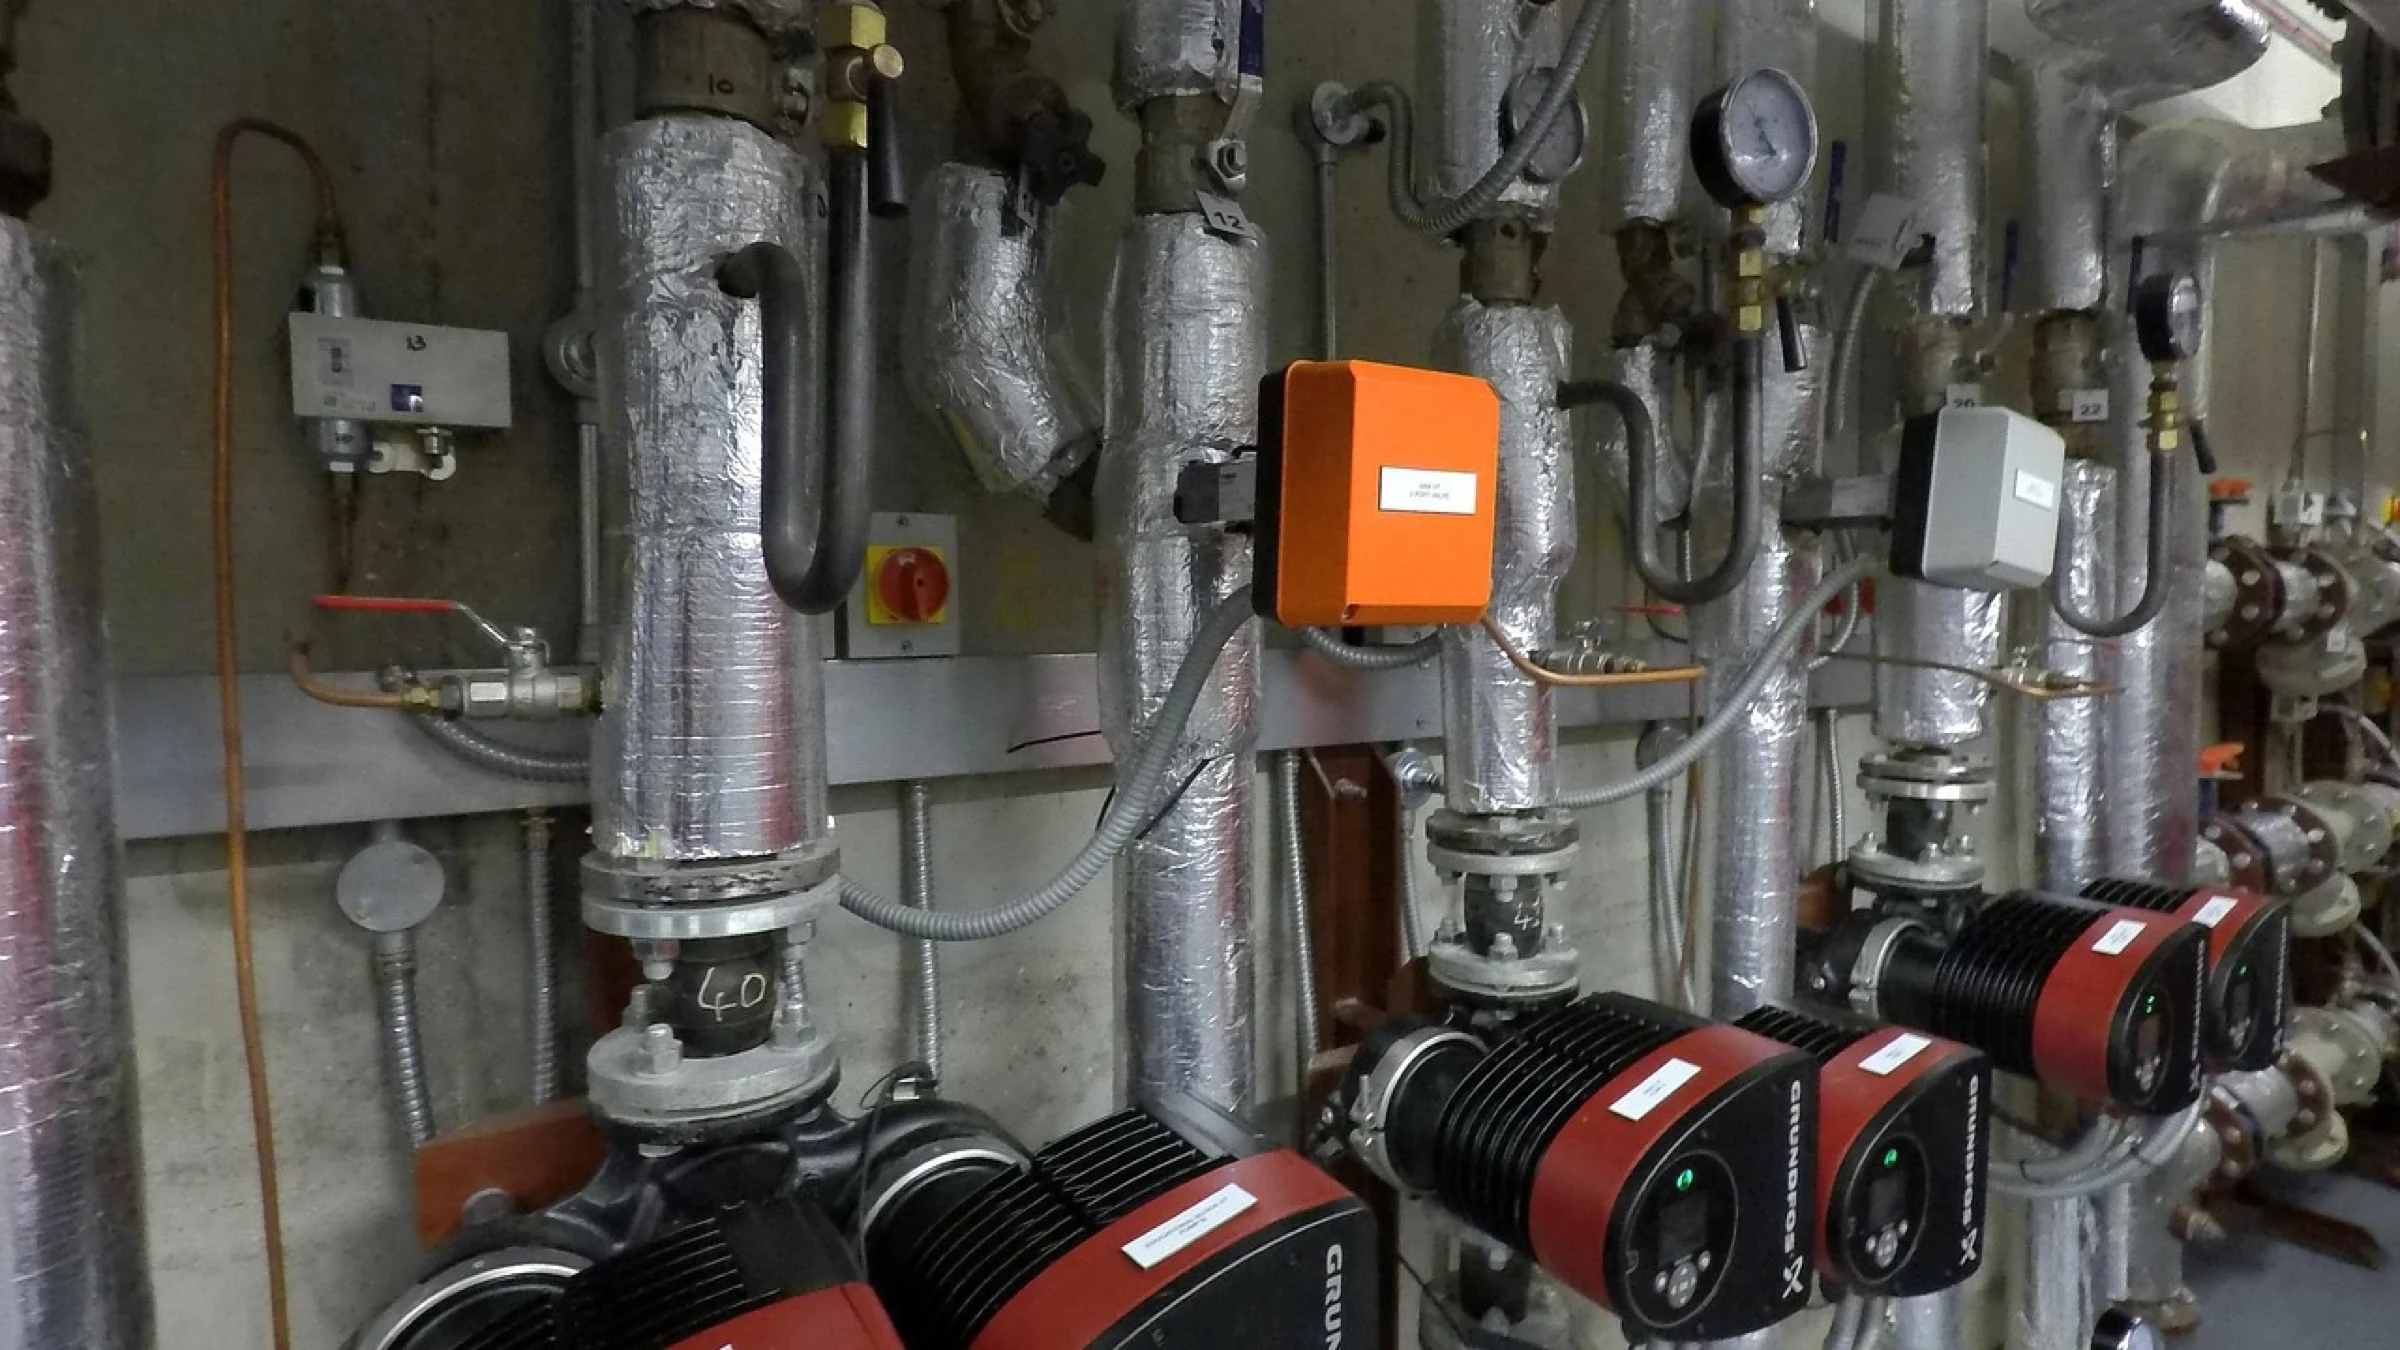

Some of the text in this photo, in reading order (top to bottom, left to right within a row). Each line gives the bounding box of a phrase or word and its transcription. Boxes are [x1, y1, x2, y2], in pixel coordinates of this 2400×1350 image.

[708, 72, 734, 95] 10
[1214, 211, 1244, 230] 12
[2080, 403, 2103, 416] 22
[697, 966, 767, 1022] 40
[1784, 1079, 1801, 1254] GRUNDFOS
[1962, 1074, 1979, 1227] GRUNDFOS
[1325, 1244, 1343, 1350] GRUN
